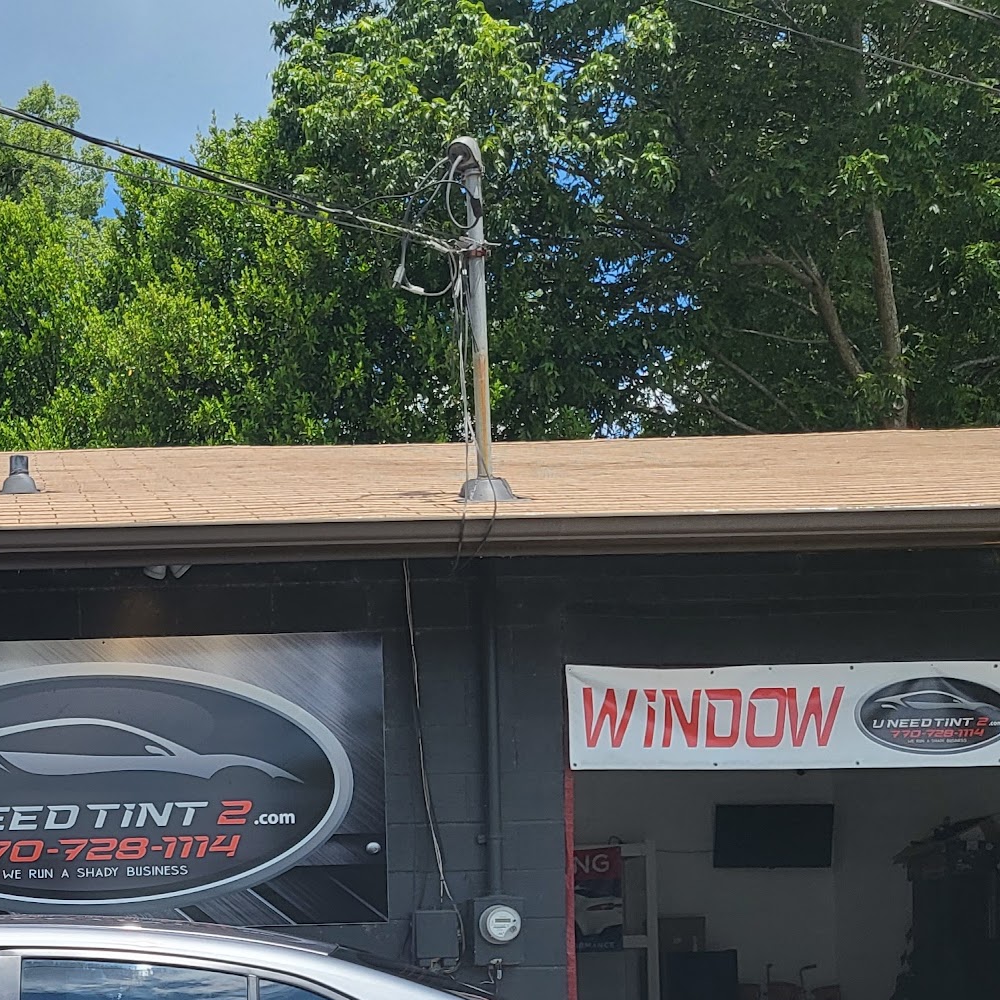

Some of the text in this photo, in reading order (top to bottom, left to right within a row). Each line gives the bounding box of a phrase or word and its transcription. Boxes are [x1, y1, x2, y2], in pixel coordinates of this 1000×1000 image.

[872, 719, 884, 729] U
[976, 716, 989, 726] 2
[890, 728, 985, 738] 770-728-1114
[217, 800, 253, 825] 2
[253, 812, 296, 825] .com
[2, 865, 189, 880] WE RUN A SHADY BUSINESS
